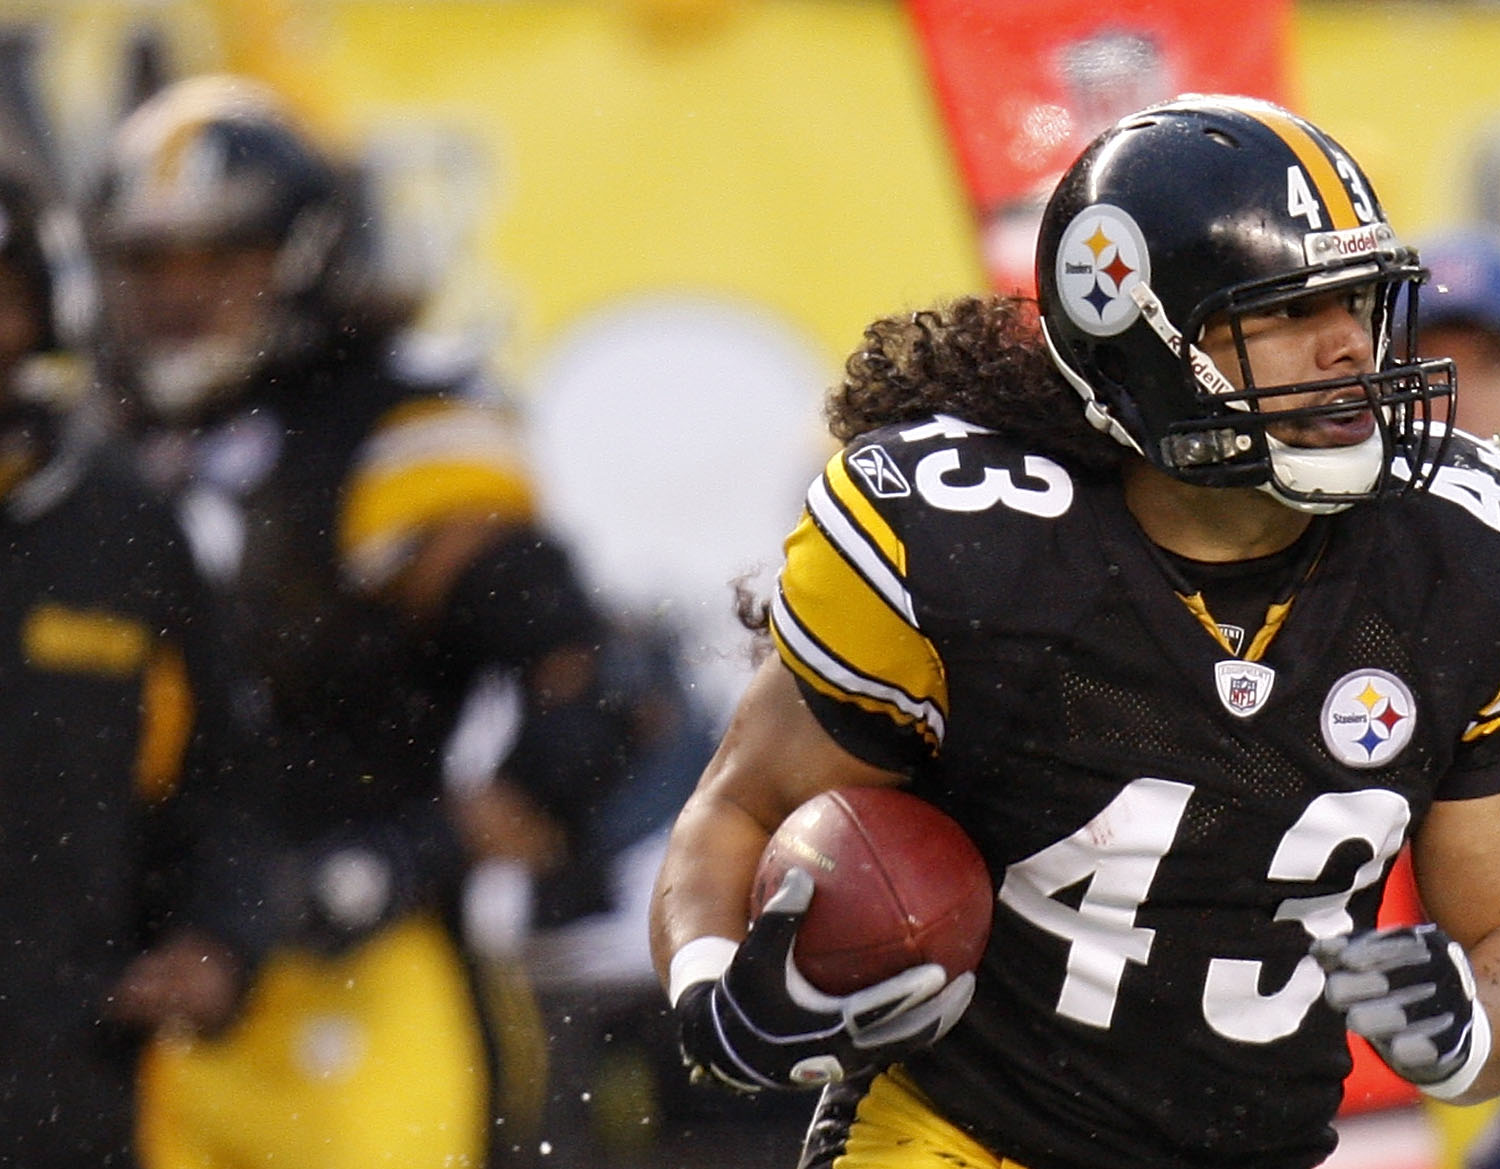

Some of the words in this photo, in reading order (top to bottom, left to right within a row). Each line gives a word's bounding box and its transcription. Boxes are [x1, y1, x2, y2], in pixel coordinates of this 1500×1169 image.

[1287, 158, 1374, 230] 43
[1333, 712, 1368, 725] Steelers
[998, 777, 1412, 1044] 43
